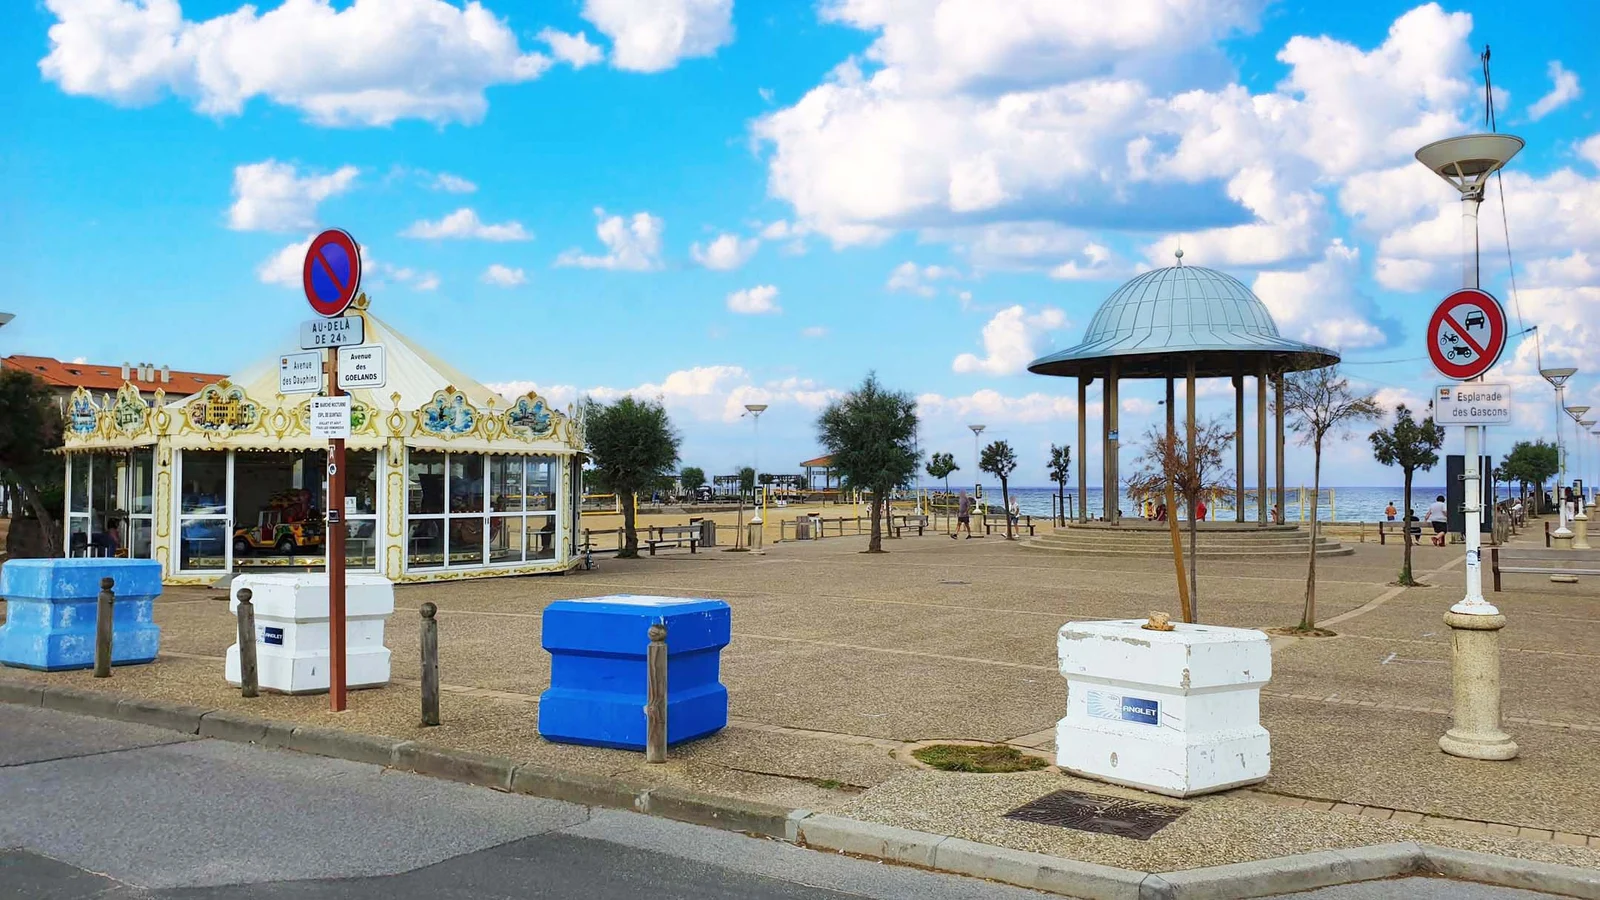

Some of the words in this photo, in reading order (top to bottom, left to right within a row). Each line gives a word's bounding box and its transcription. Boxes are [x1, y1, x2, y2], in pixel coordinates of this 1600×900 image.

[315, 334, 327, 345] DE
[330, 333, 347, 344] 24h
[350, 352, 372, 360] Avenue
[293, 361, 312, 370] Avenue
[355, 363, 367, 371] des
[282, 376, 292, 386] des
[293, 374, 317, 386] Dauphins
[345, 373, 378, 382] GOELANDS
[1457, 392, 1502, 403] Esplanade
[1452, 407, 1468, 417] des
[1470, 407, 1508, 417] Gascons
[1122, 705, 1156, 716] ANGLET
